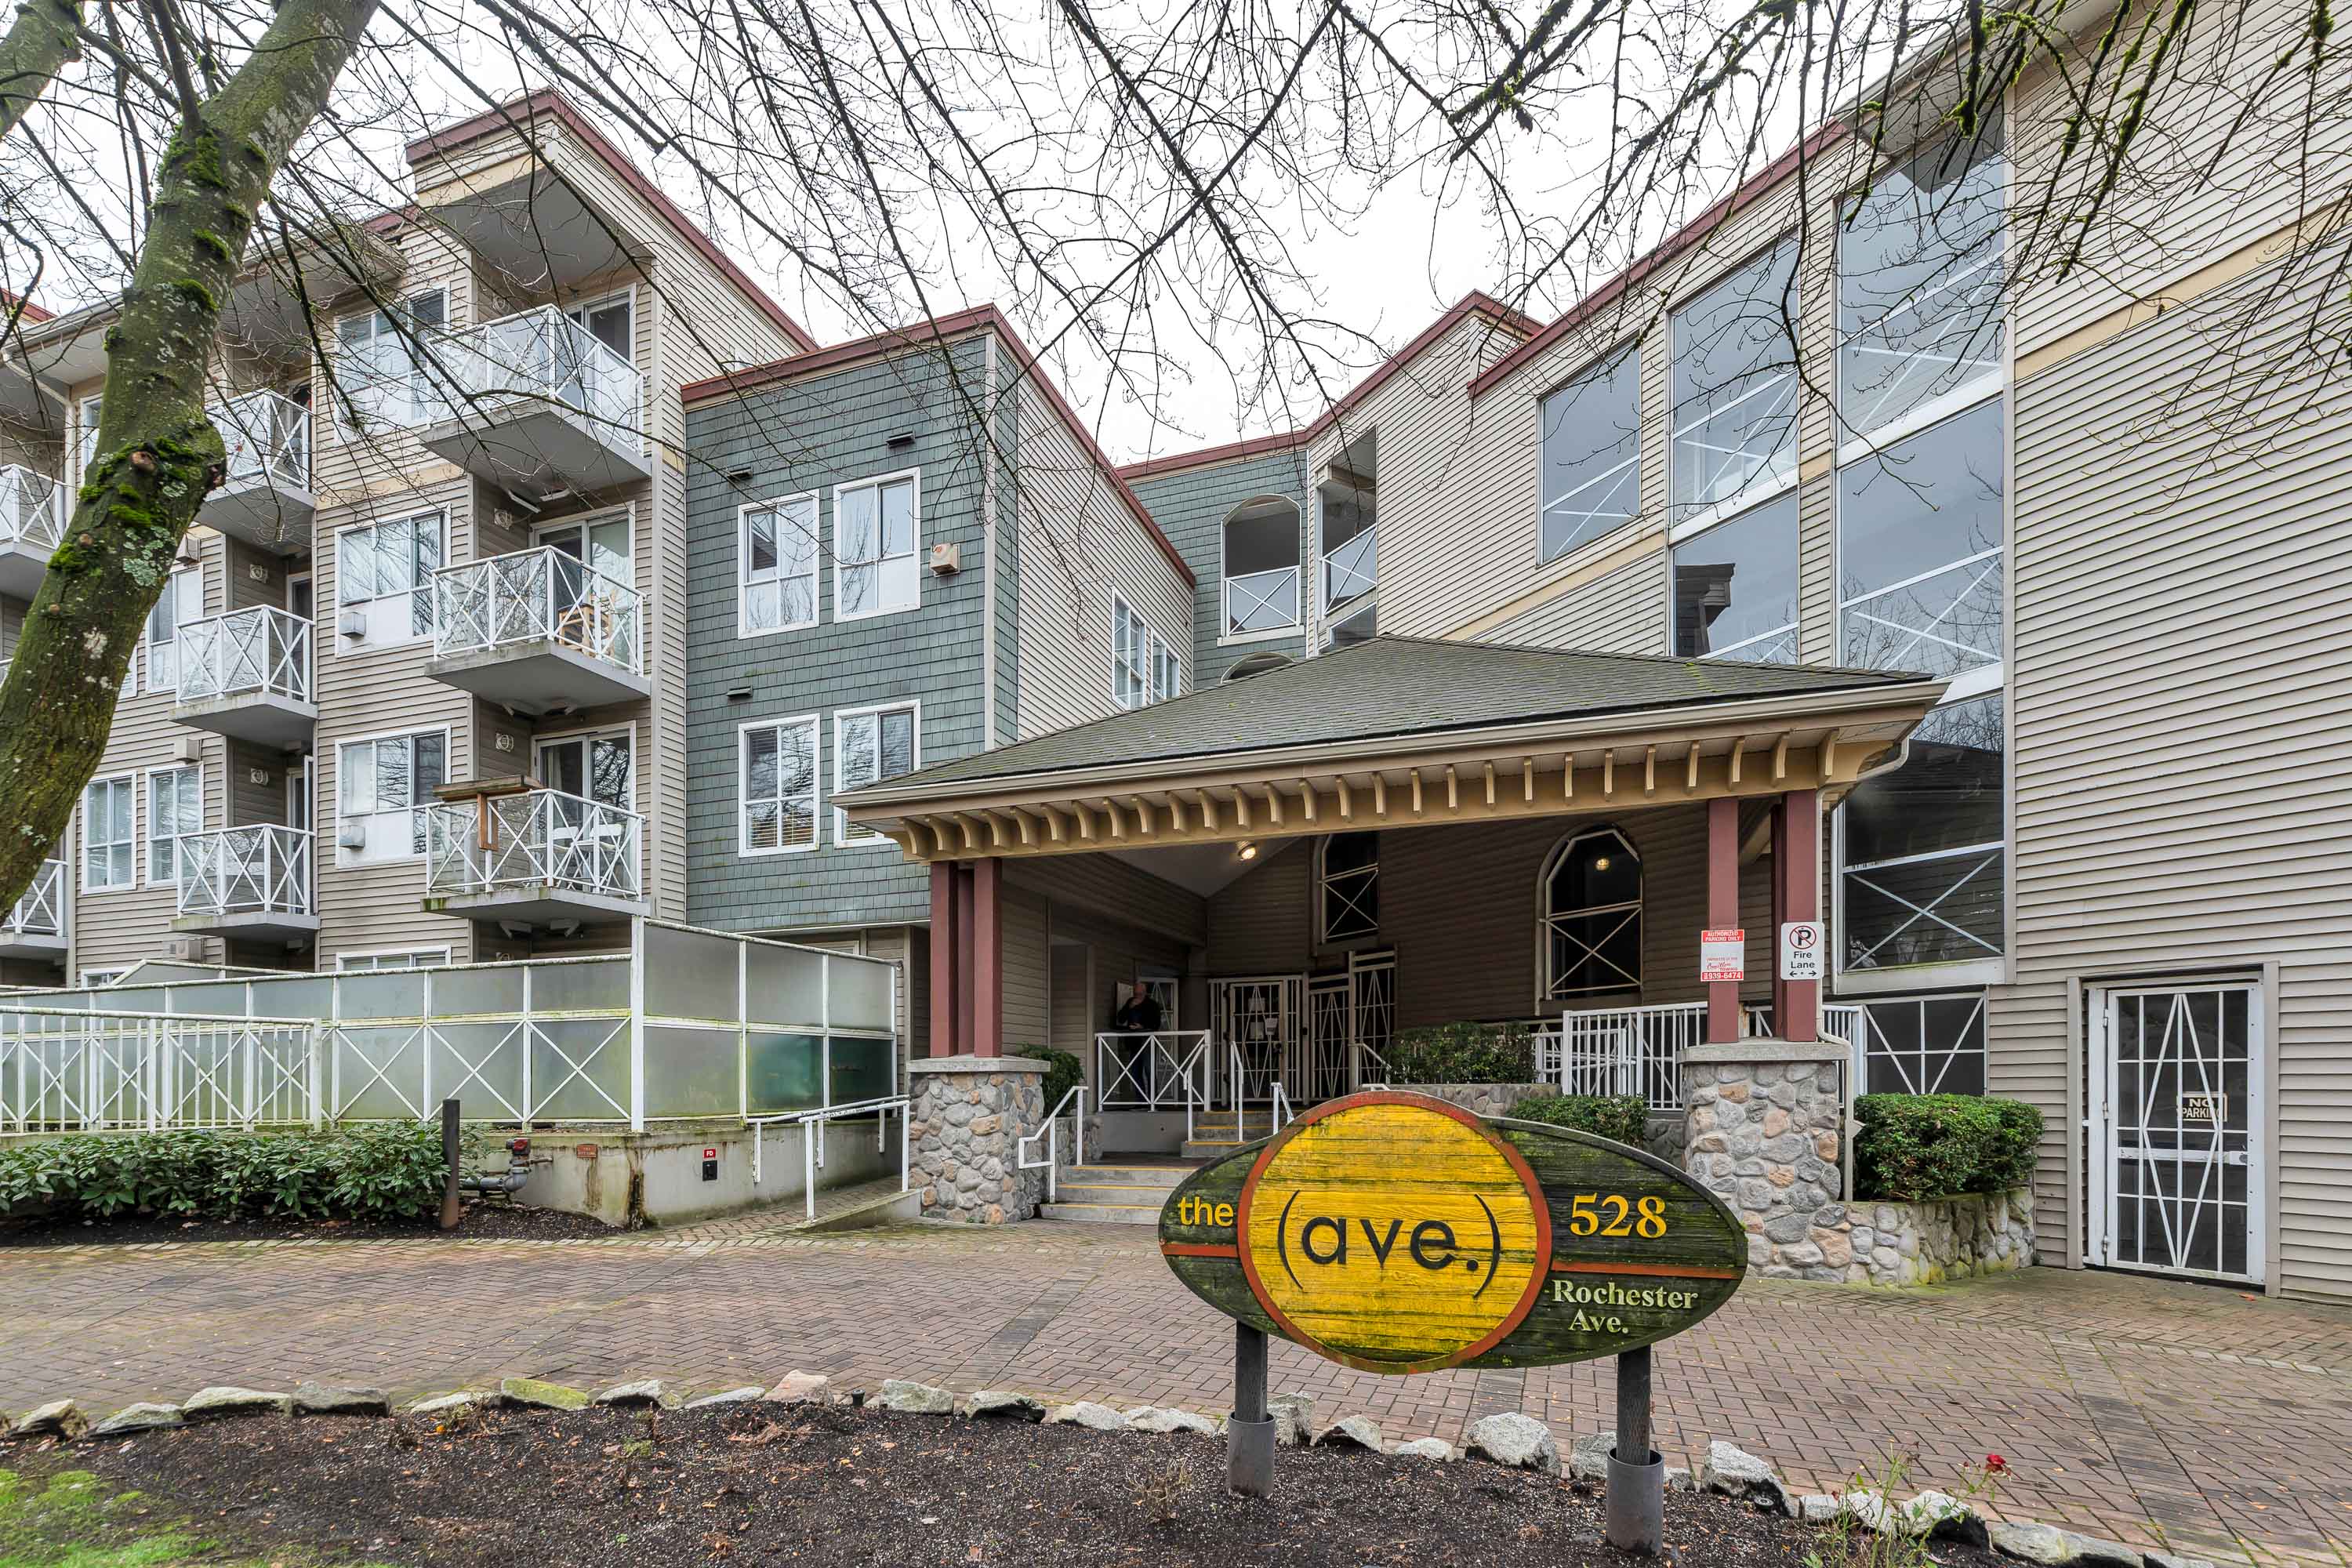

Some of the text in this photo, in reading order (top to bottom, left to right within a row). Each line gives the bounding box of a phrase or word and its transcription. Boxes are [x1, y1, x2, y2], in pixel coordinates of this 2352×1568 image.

[2176, 1107, 2223, 1119] PARKI
[2189, 1098, 2215, 1107] NO
[1570, 1192, 1668, 1239] 528
[1178, 1189, 1501, 1299] the (ave.)
[1552, 1279, 1699, 1309] Rochester
[1569, 1308, 1629, 1334] Ave.
